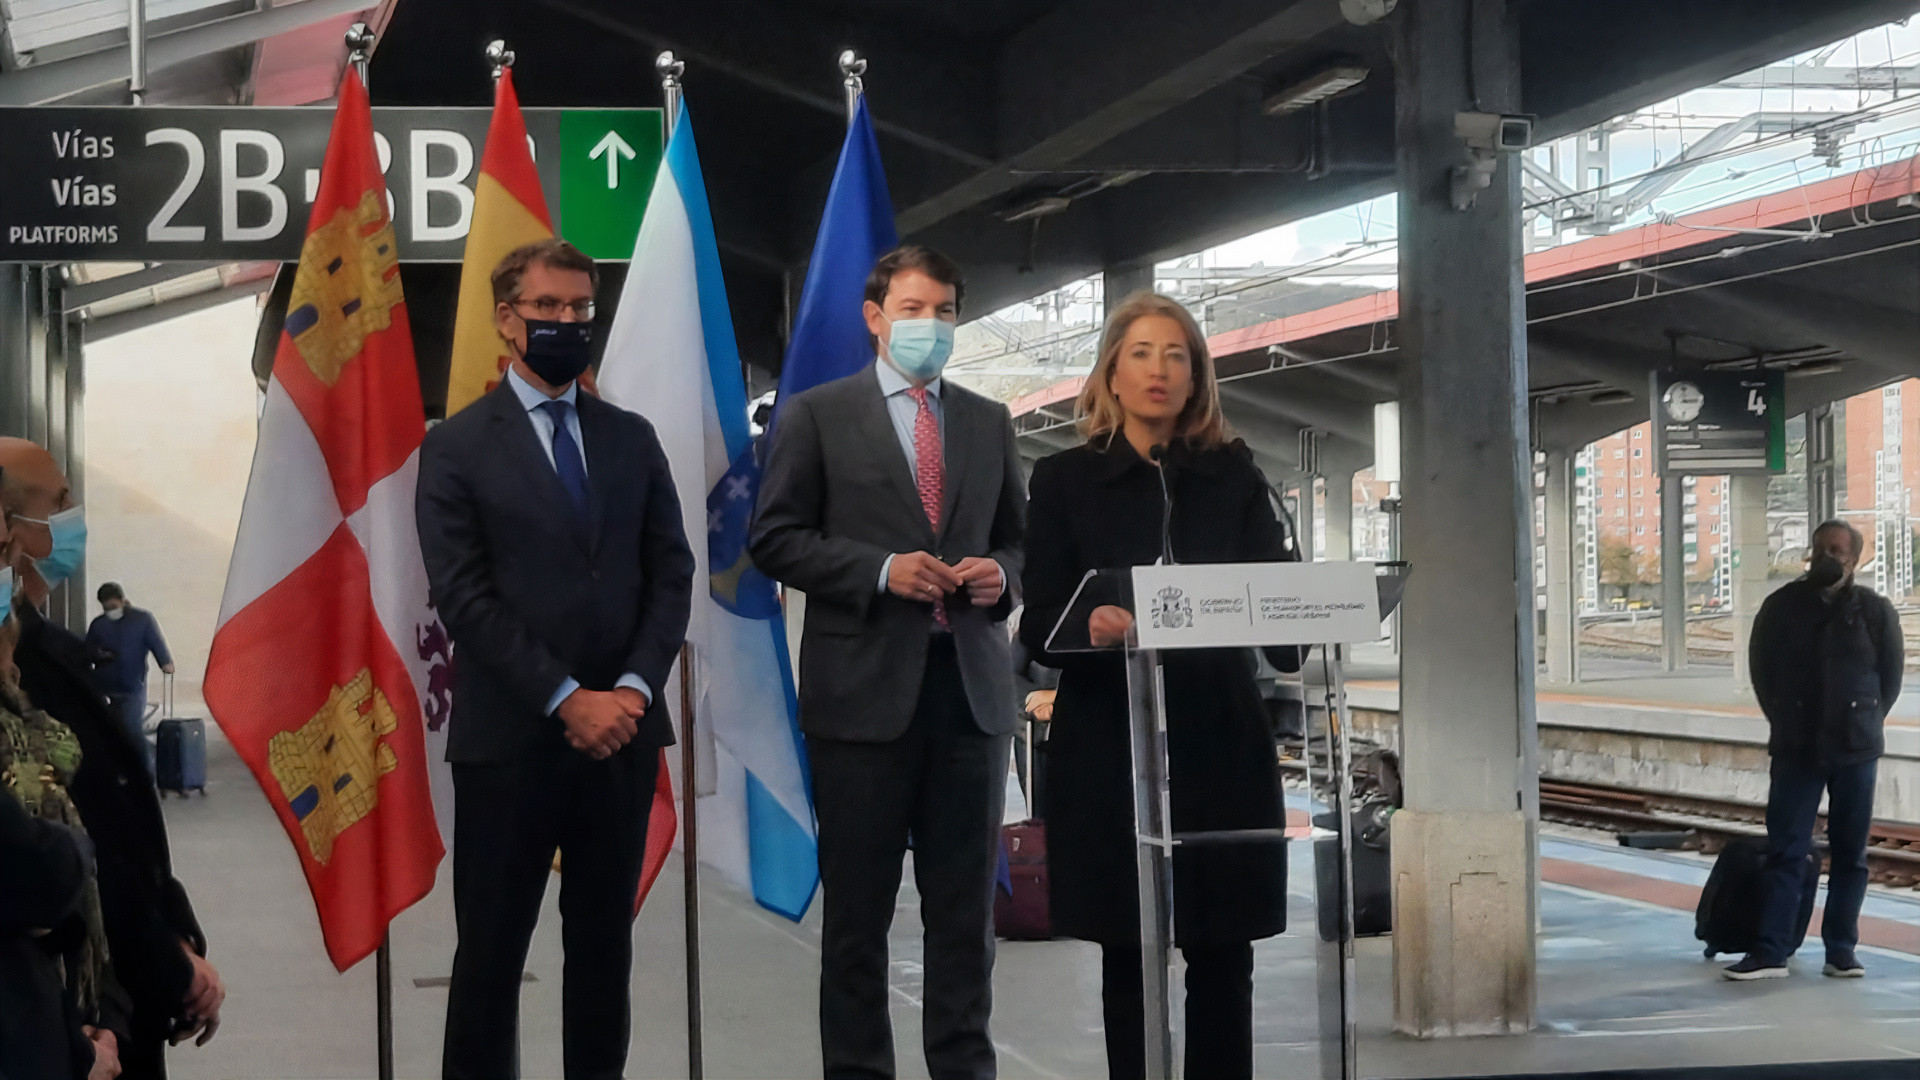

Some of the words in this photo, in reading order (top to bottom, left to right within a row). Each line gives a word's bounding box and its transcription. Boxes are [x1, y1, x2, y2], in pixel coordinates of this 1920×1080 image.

[52, 129, 115, 159] Vías
[51, 176, 117, 206] Vías
[9, 225, 119, 244] PLATFORMS
[1747, 389, 1767, 416] 4
